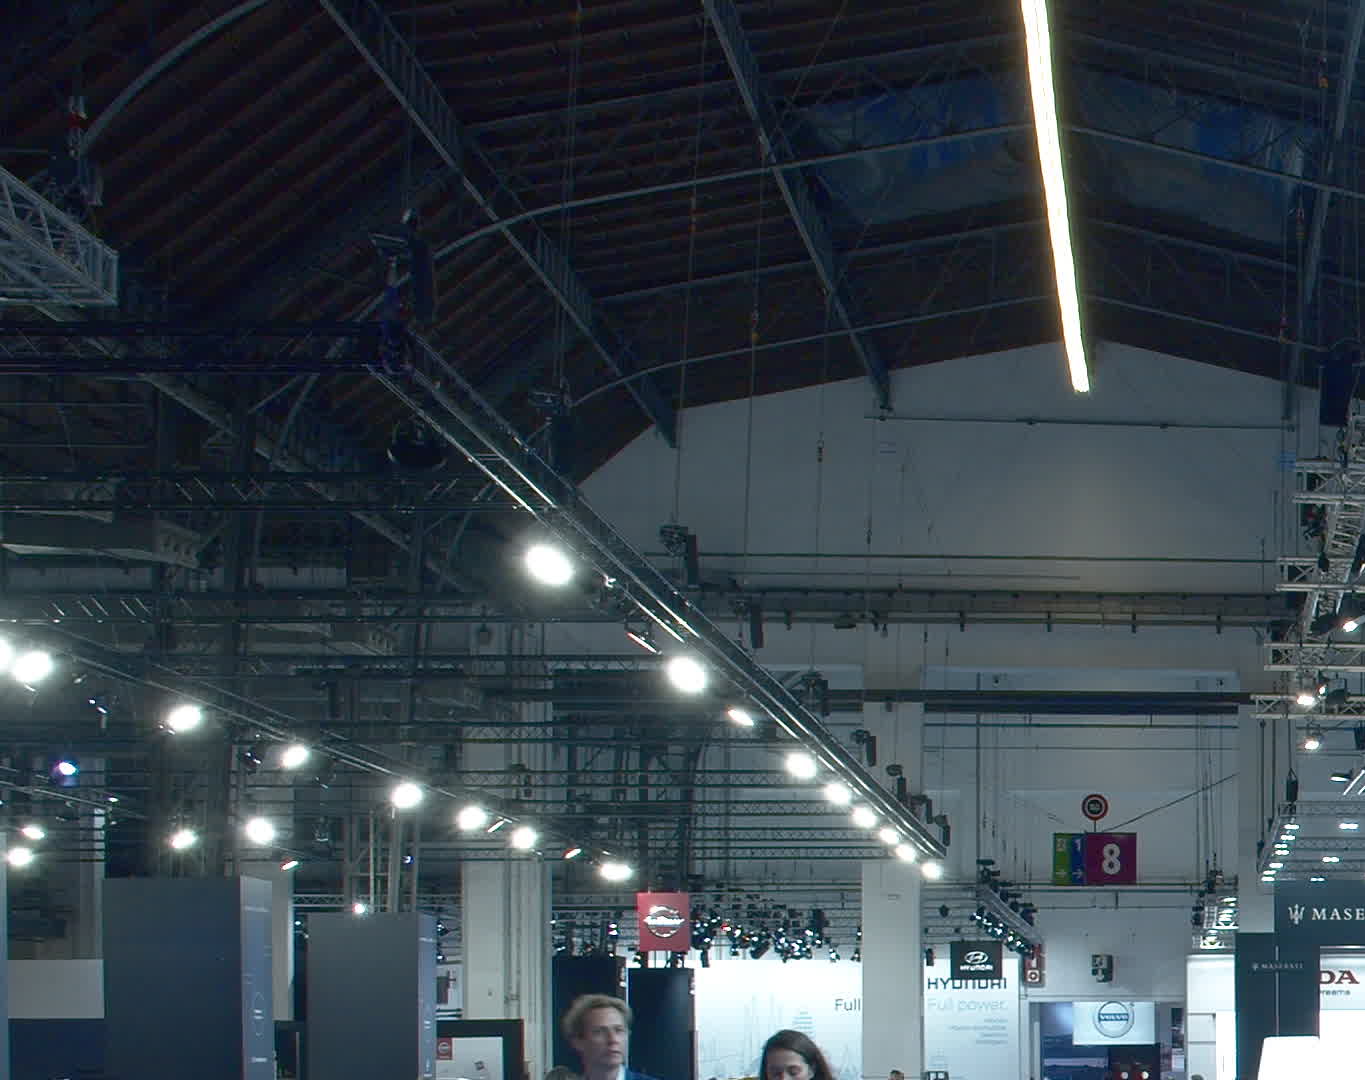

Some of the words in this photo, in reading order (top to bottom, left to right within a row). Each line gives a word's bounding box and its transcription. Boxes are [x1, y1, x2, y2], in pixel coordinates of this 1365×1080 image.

[1103, 843, 1121, 875] 8
[959, 963, 994, 972] HYUNDAI
[834, 998, 861, 1012] Full
